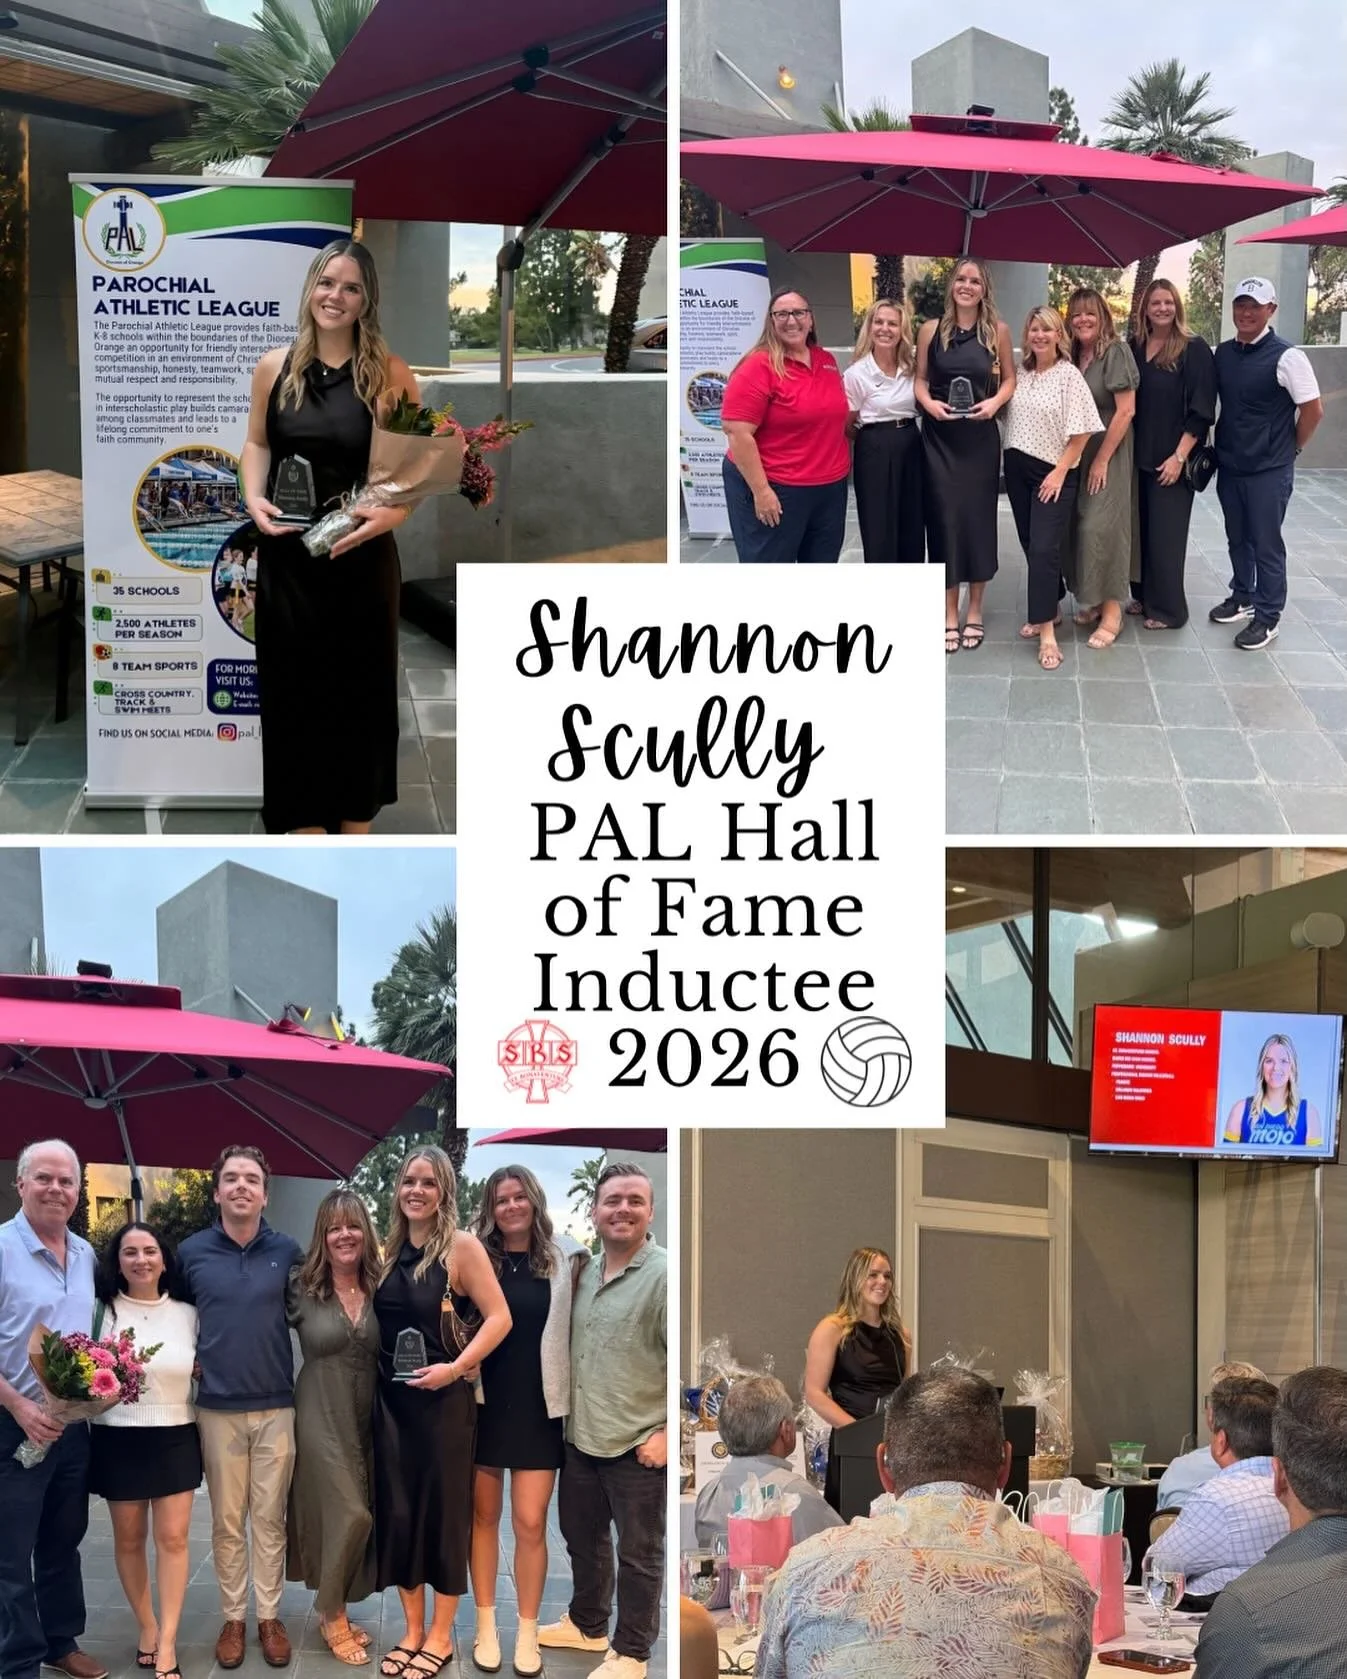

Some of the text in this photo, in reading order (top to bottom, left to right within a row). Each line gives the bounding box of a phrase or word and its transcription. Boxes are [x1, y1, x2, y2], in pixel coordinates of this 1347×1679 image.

[105, 226, 144, 251] PAL
[92, 276, 215, 293] PAROCHIAL
[93, 299, 280, 317] ATHLETIC LEAGUE
[700, 299, 739, 308] LEAGUE
[94, 321, 109, 330] The
[111, 321, 153, 330] Parochial
[155, 322, 188, 331] Athletic
[190, 322, 221, 333] League
[223, 323, 260, 333] provides
[94, 332, 108, 340] K-8
[110, 333, 143, 341] schools
[146, 333, 172, 341] within
[174, 333, 188, 341] the
[190, 333, 238, 342] boundaries
[240, 334, 249, 342] of
[251, 334, 265, 342] the
[94, 342, 125, 353] Orange
[127, 344, 137, 352] an
[140, 343, 189, 353] opportunity
[192, 344, 203, 352] for
[206, 344, 238, 355] friendly
[94, 354, 145, 363] competition
[148, 354, 156, 362] in
[171, 355, 223, 363] environment
[226, 355, 234, 363] of
[95, 364, 160, 374] sportsmanship,
[163, 365, 199, 375] honesty,
[201, 367, 244, 375] teamwork,
[95, 375, 124, 383] mutual
[126, 376, 158, 386] respect
[179, 376, 237, 386] responsibility.
[96, 392, 110, 401] The
[113, 393, 161, 404] opportunity
[164, 394, 173, 402] to
[175, 394, 215, 404] represent
[217, 394, 231, 402] the
[96, 404, 103, 412] in
[105, 404, 168, 413] interscholastic
[171, 404, 188, 414] play
[190, 404, 216, 413] builds
[96, 415, 125, 425] among
[127, 414, 176, 423] classmates
[178, 414, 194, 423] and
[196, 414, 219, 423] leads
[221, 415, 230, 423] to
[96, 424, 127, 435] lifelong
[129, 425, 183, 433] commitment
[196, 425, 218, 433] one's
[96, 435, 167, 445] faith community.
[113, 586, 180, 595] 35 SCHOOLS
[115, 619, 197, 629] 2,500 ATHLETES
[115, 630, 183, 639] PER SEASON
[122, 662, 151, 671] TEAM
[155, 662, 198, 671] SPORTS
[215, 663, 233, 674] FOR
[215, 675, 237, 686] VISIT
[114, 690, 145, 698] CROSS
[114, 706, 171, 714] SWIM MEETS
[98, 728, 214, 738] FIND US ON SOCIAL MEDIA:
[1115, 1031, 1206, 1046] SHANNON SCULLY
